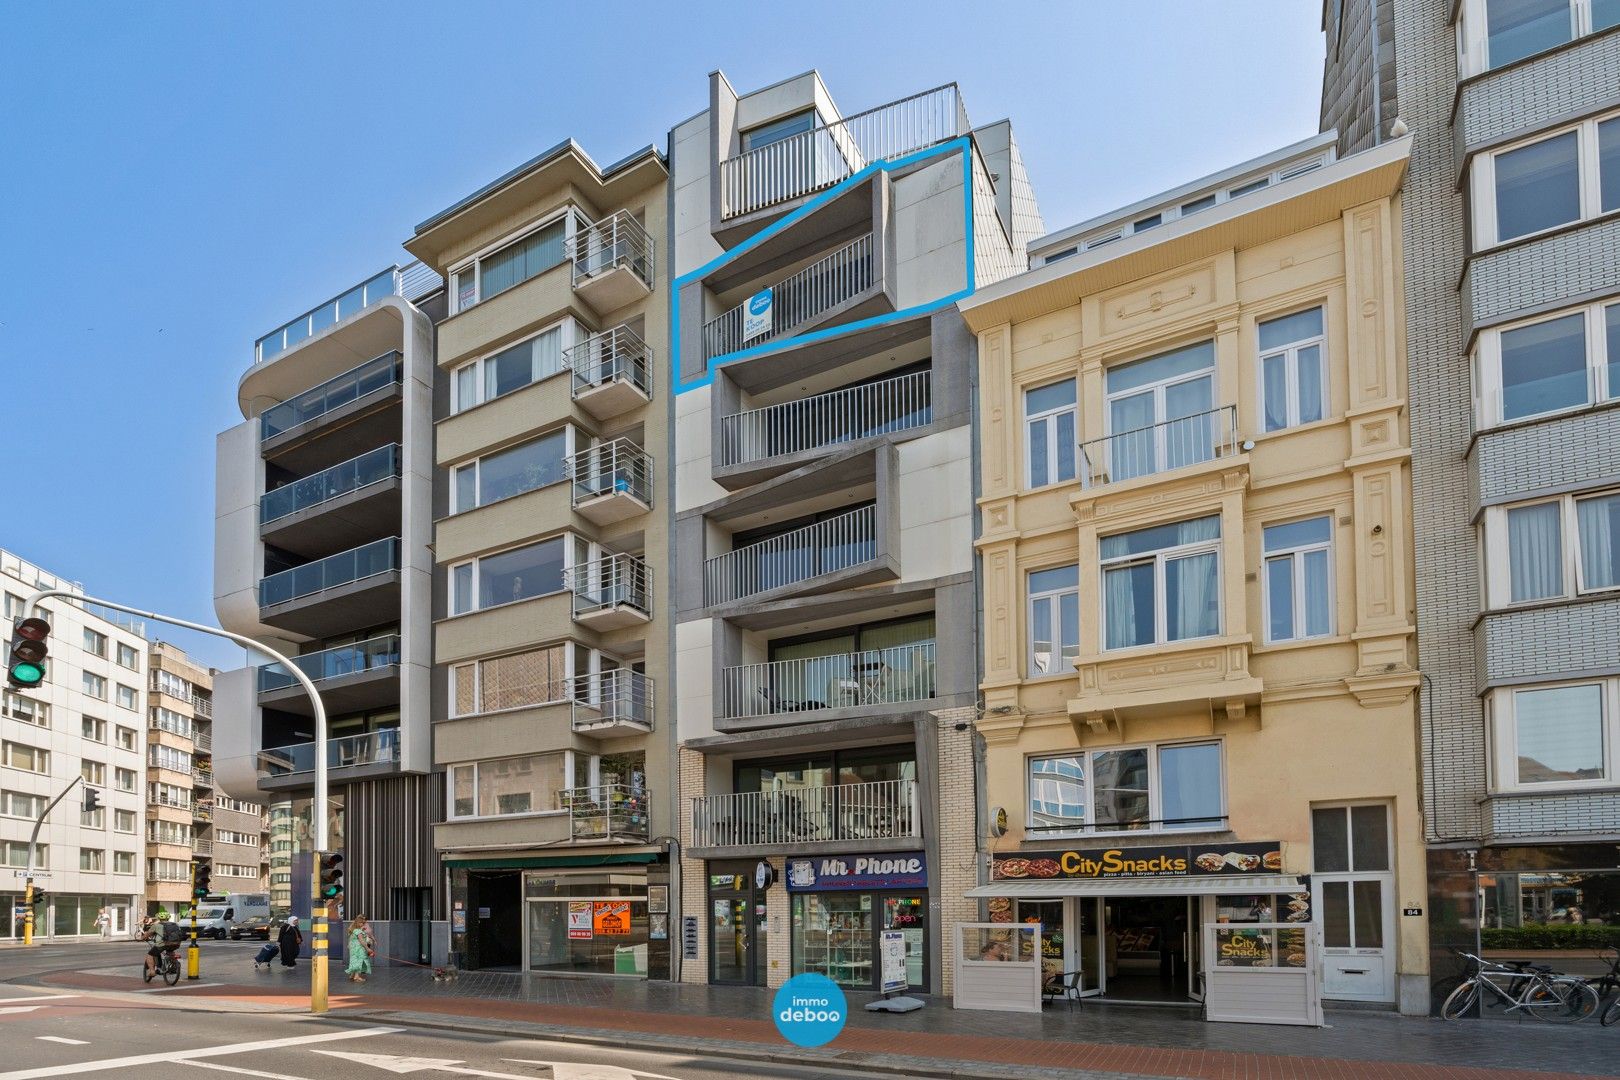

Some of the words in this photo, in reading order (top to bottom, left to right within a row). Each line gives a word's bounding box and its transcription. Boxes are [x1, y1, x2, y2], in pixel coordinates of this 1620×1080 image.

[855, 857, 923, 875] Phone
[1061, 851, 1102, 877] City
[1103, 849, 1187, 873] Snacks
[1221, 943, 1267, 957] Snacks
[1231, 935, 1257, 950] City
